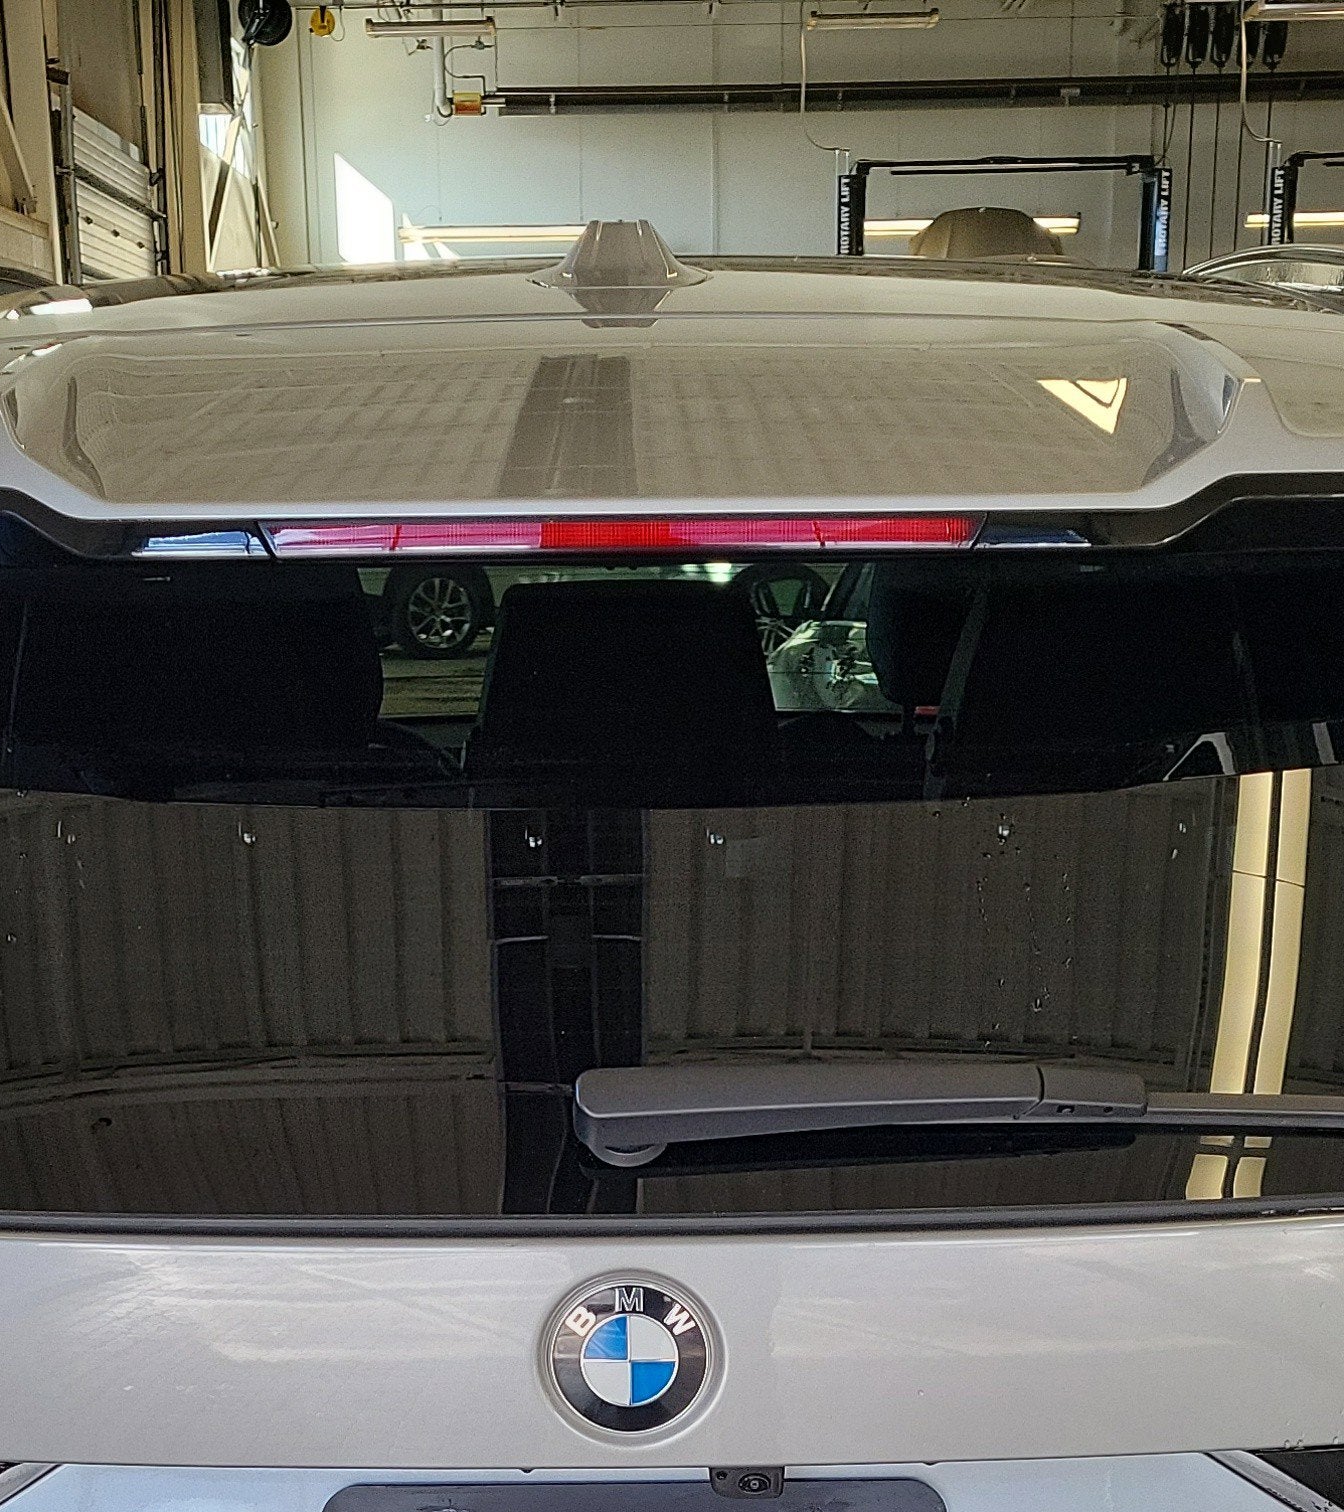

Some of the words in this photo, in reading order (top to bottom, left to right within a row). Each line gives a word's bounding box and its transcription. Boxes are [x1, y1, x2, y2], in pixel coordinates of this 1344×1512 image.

[840, 176, 850, 203] LIFT
[1274, 168, 1285, 195] LIFT
[840, 206, 850, 254] ROTARY
[565, 1287, 696, 1337] BMW
